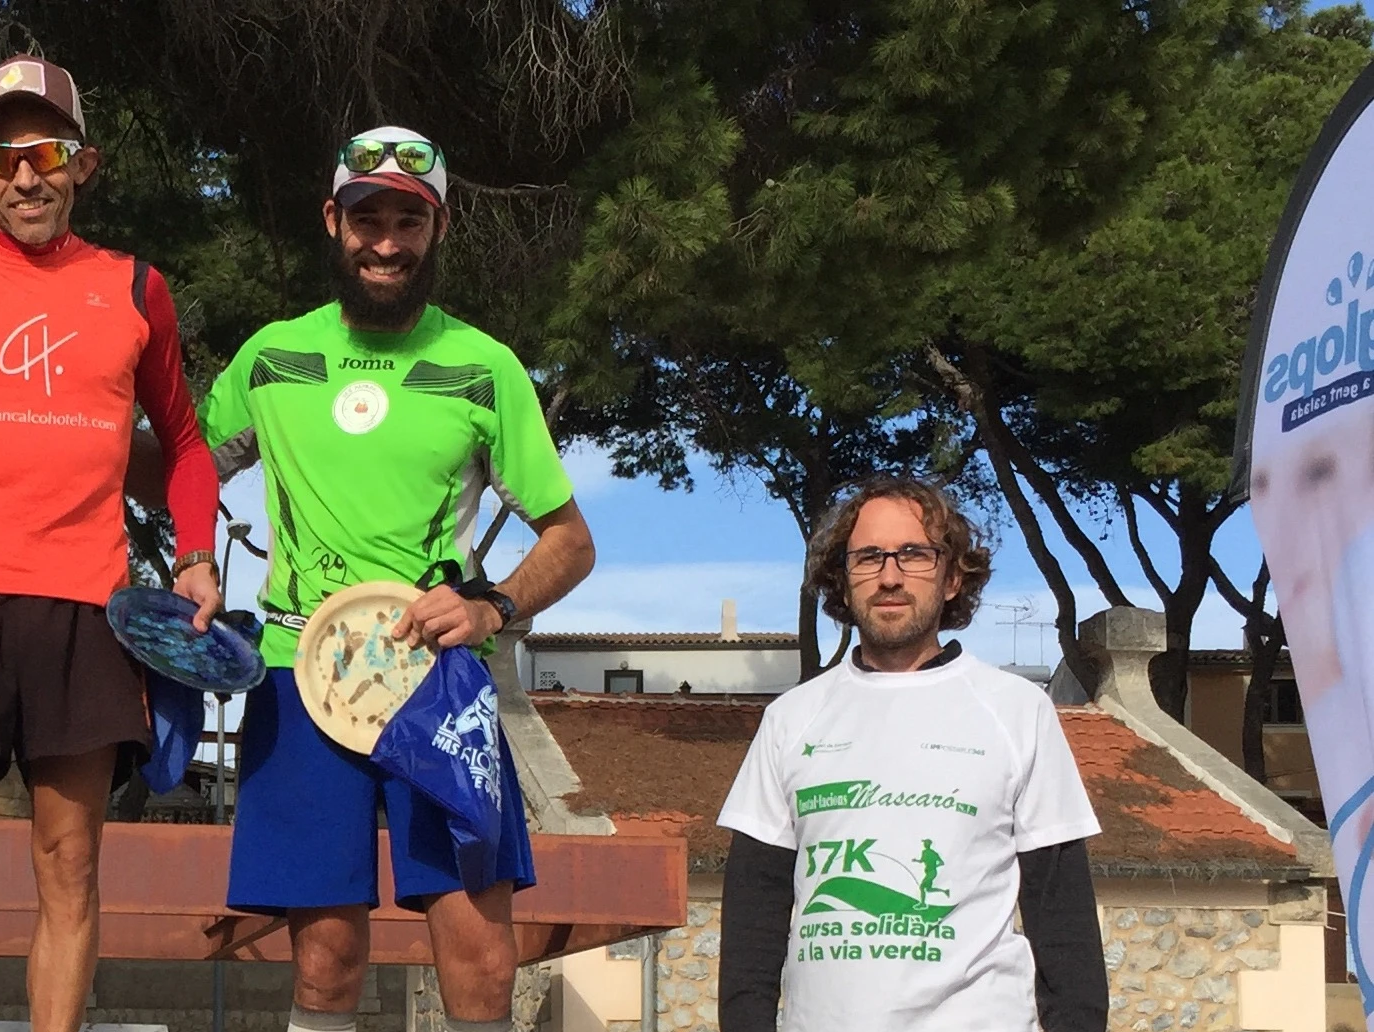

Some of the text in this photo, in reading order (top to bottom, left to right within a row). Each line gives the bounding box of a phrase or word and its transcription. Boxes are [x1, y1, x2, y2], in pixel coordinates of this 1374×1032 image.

[337, 357, 395, 371] Joma
[847, 783, 960, 809] Mascaró
[799, 913, 956, 941] cursa solidària
[797, 940, 942, 962] a la via verda
